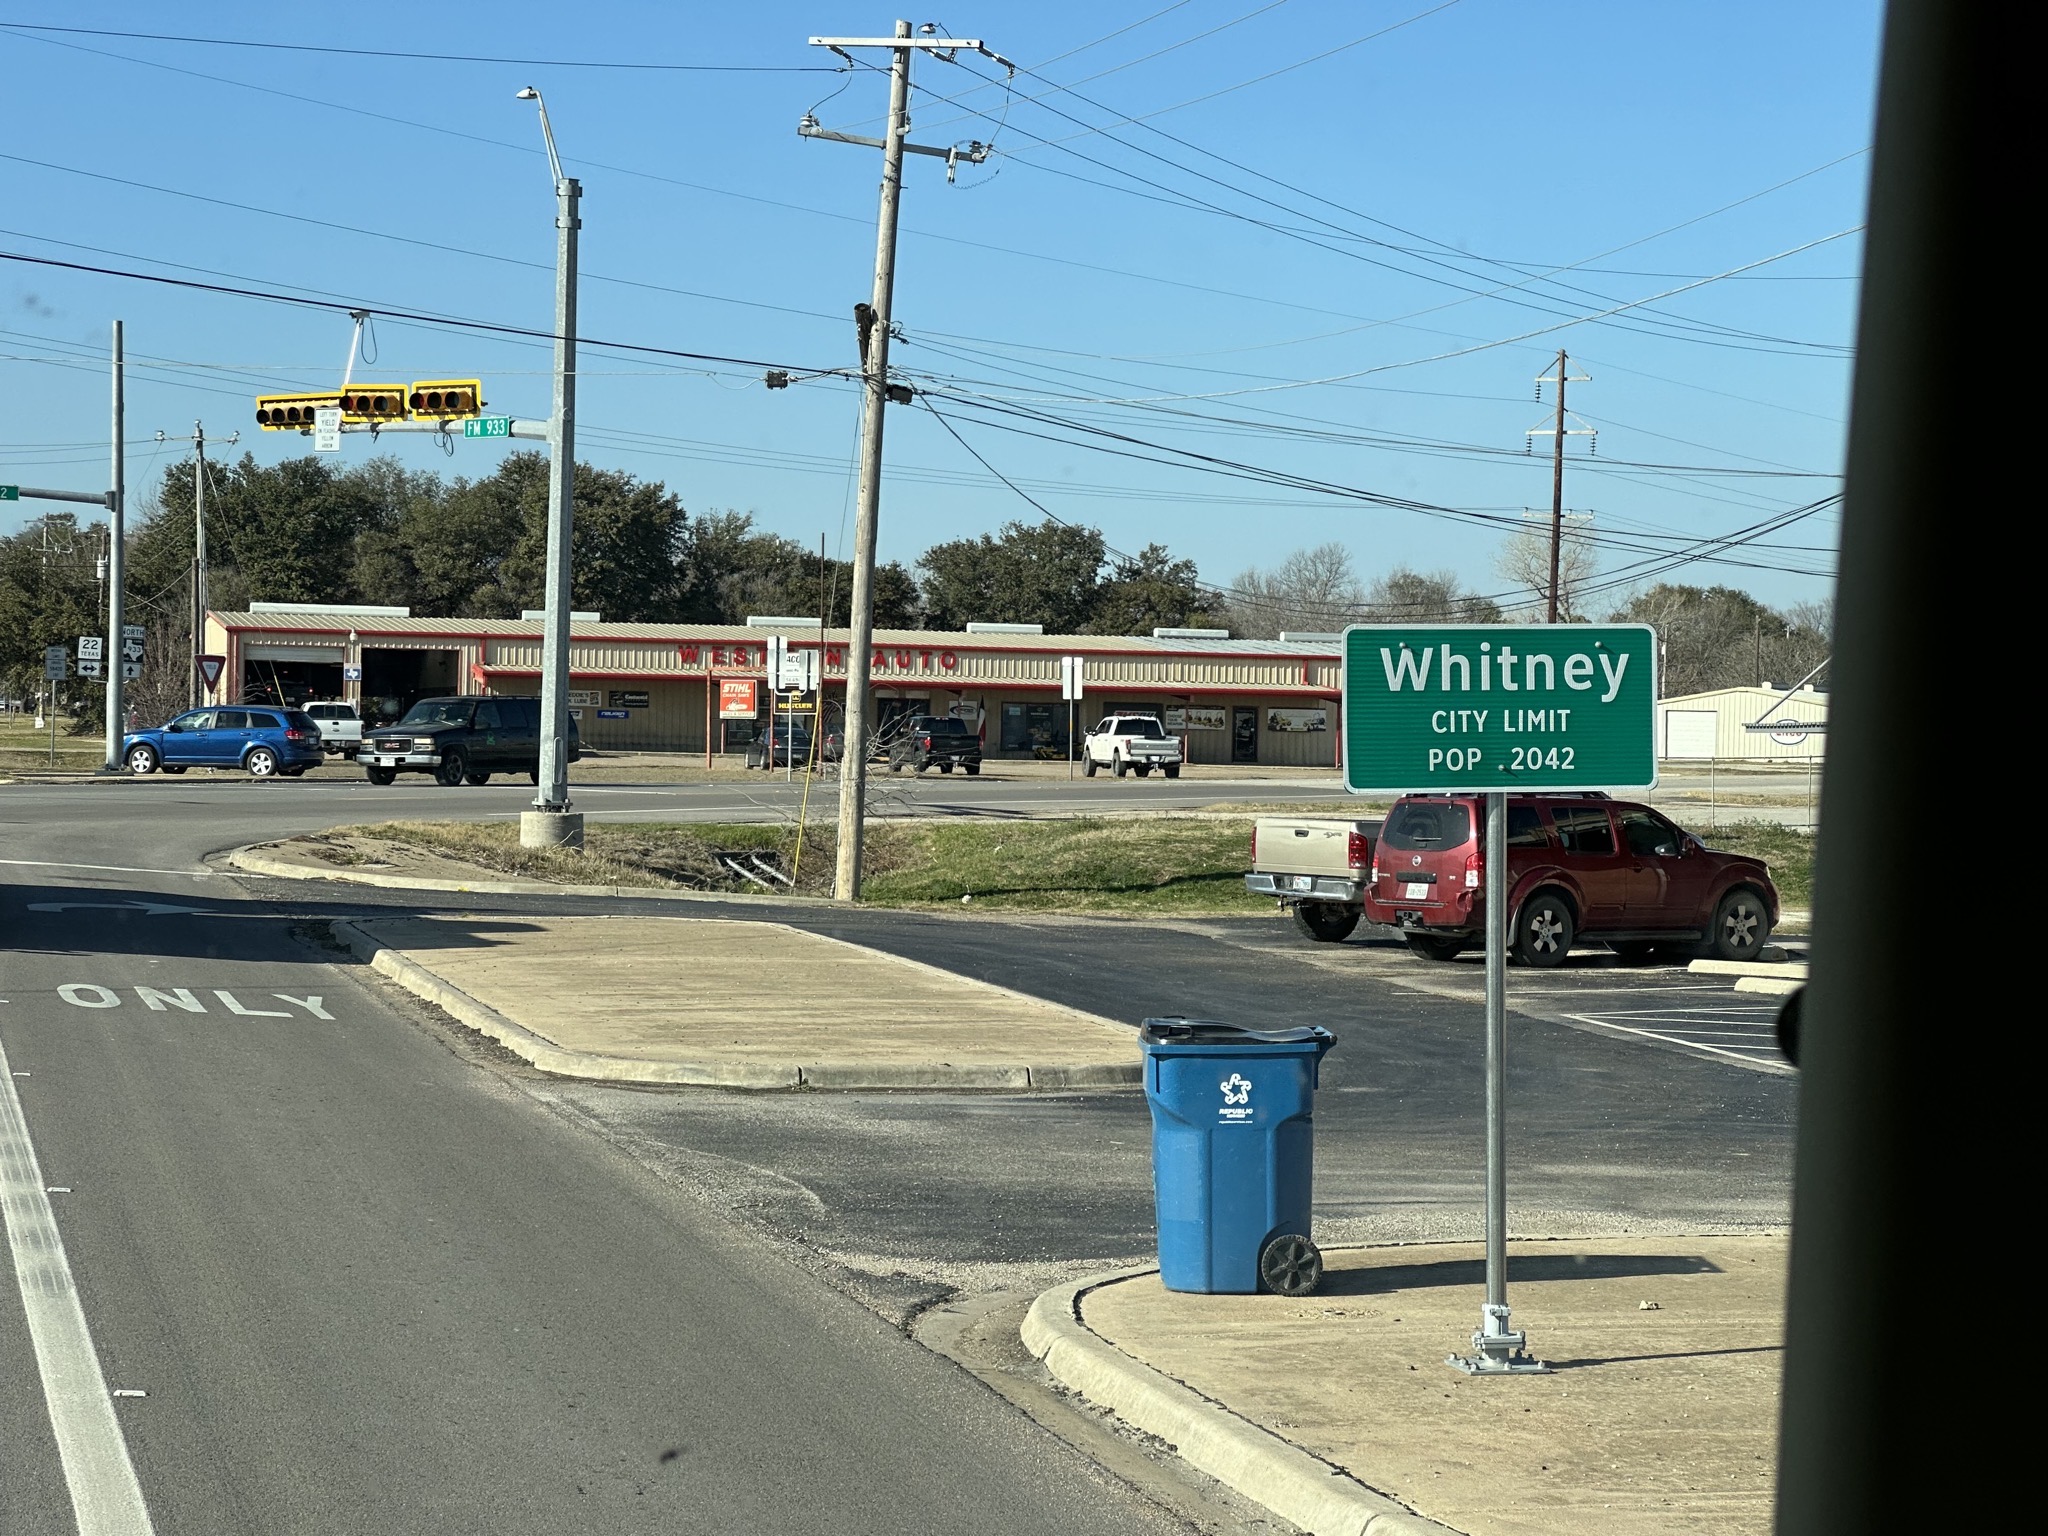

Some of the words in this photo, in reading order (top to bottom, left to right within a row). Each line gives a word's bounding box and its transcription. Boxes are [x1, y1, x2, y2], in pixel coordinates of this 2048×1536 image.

[467, 421, 480, 436] FM
[487, 420, 505, 435] 933
[82, 639, 98, 650] 22
[872, 650, 957, 670] AUTO
[1380, 642, 1630, 703] Whitney
[722, 684, 752, 693] STIHL
[1432, 710, 1489, 733] CITY
[1504, 709, 1571, 732] LIMIT
[1428, 748, 1482, 771] POP
[1511, 746, 1576, 770] 2042
[57, 983, 336, 1020] ONLY
